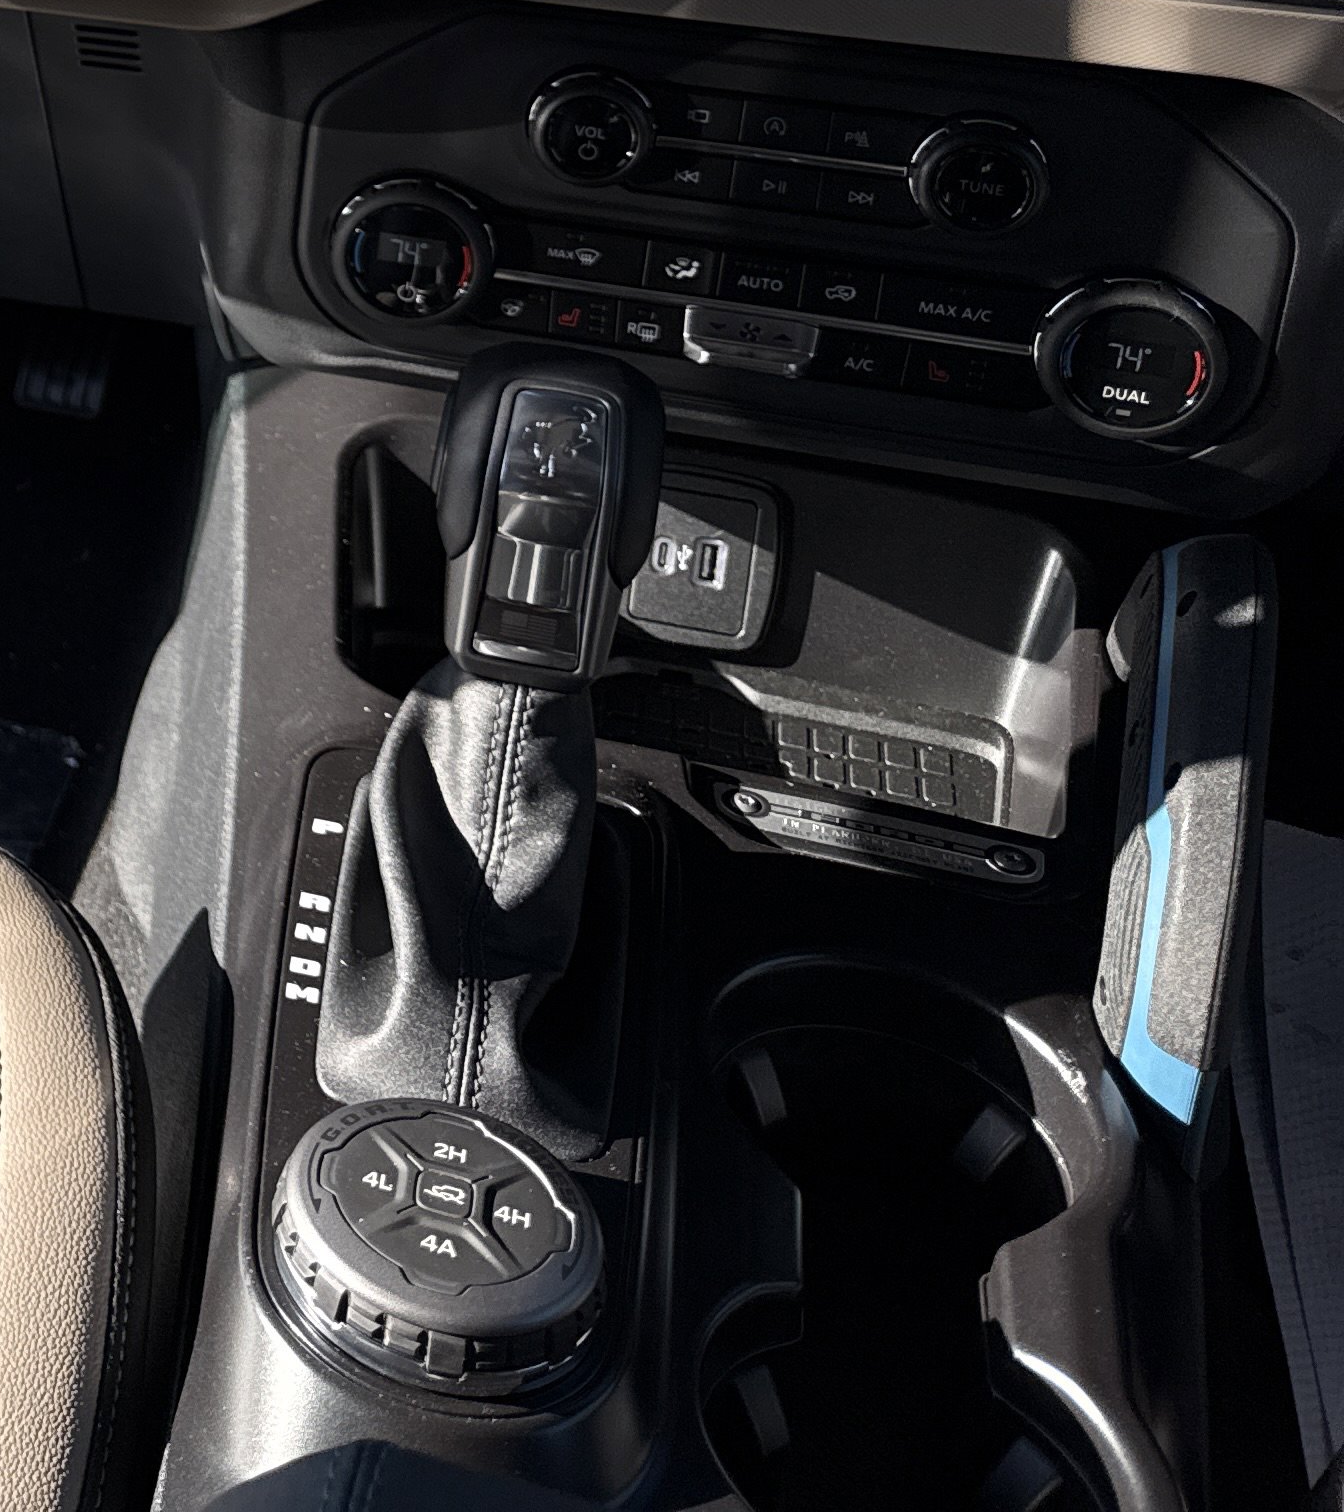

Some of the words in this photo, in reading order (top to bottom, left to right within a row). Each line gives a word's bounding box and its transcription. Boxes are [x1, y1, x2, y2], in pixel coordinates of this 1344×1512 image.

[574, 124, 607, 141] VOL
[959, 178, 1005, 197] TUNE
[547, 246, 574, 261] MAX
[737, 274, 784, 292] AUTO
[918, 300, 957, 318] MAX
[960, 306, 994, 323] A/C
[844, 356, 874, 373] A/C
[1102, 384, 1150, 405] DUAL
[294, 922, 327, 944] N
[285, 982, 320, 1004] M
[433, 1142, 467, 1164] 2H
[362, 1171, 394, 1192] 4L
[493, 1206, 532, 1229] 4H
[420, 1234, 457, 1258] 4A
